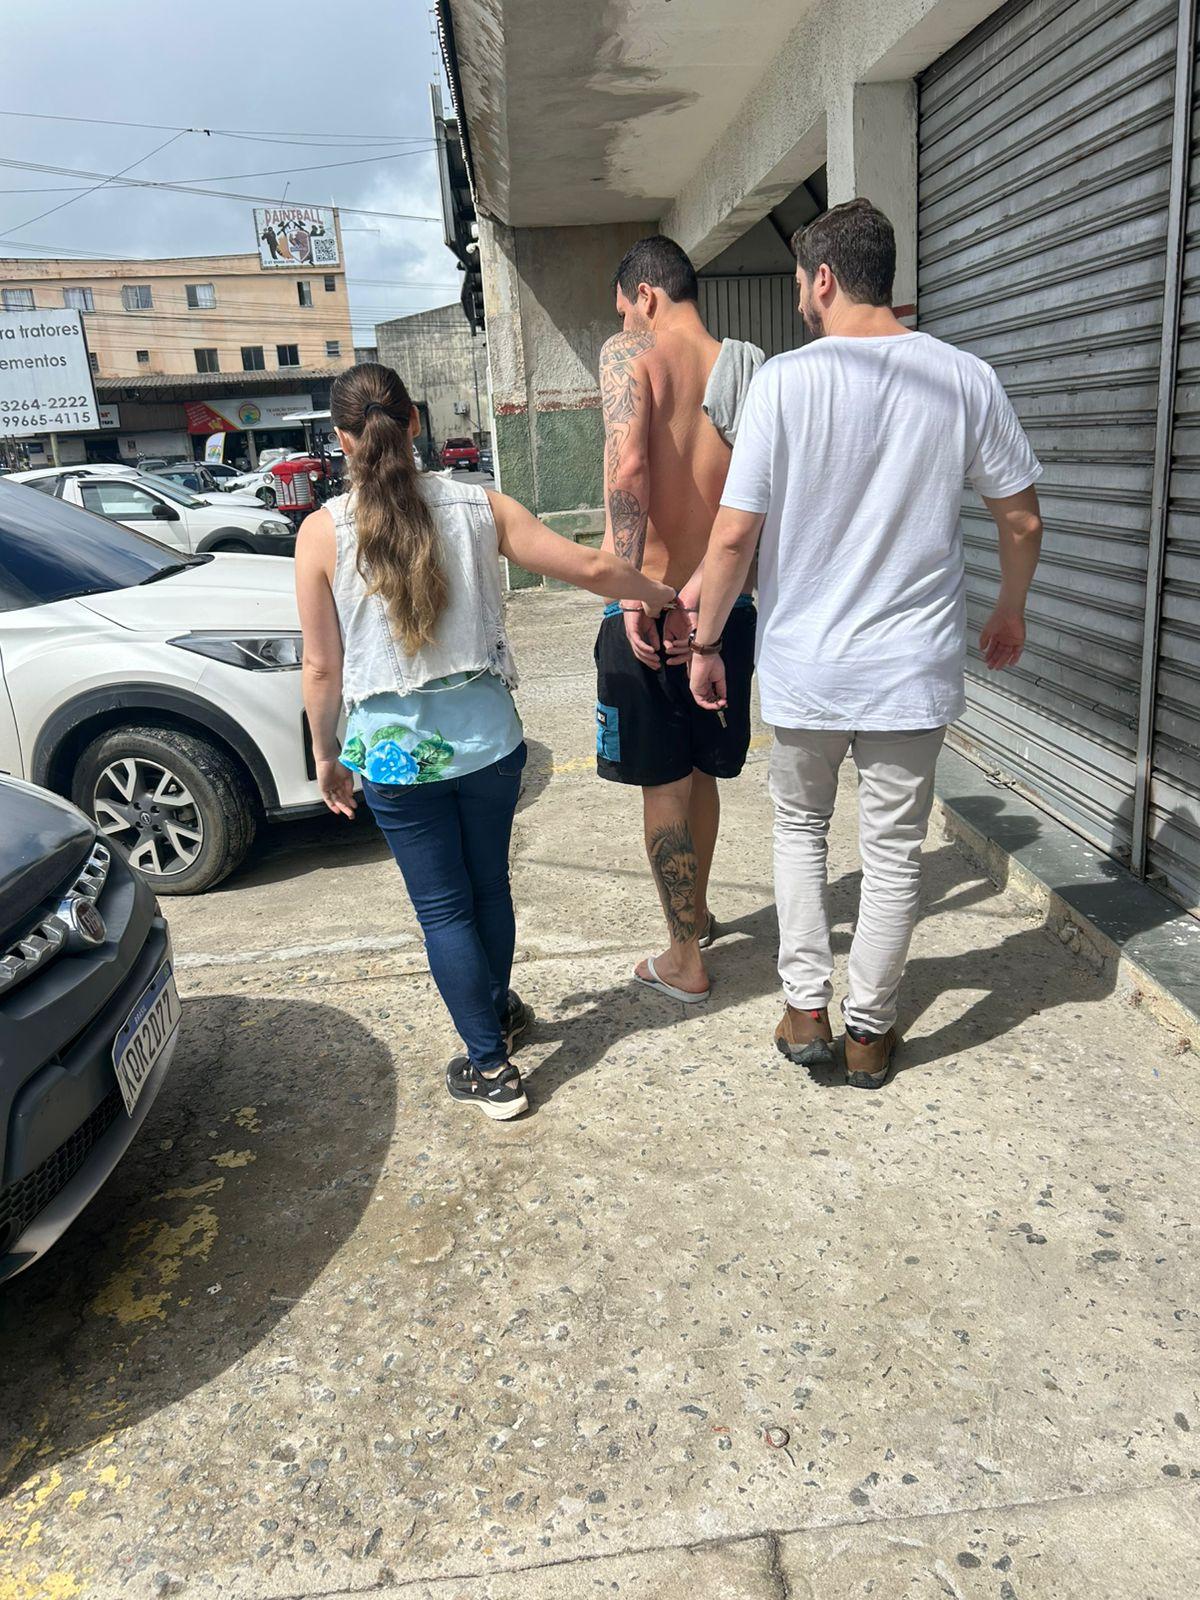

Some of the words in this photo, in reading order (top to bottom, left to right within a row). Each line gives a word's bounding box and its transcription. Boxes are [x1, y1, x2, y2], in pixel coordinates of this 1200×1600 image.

[264, 209, 324, 227] PAINTBALL
[19, 323, 79, 339] tratores
[0, 354, 67, 370] ementos
[0, 396, 88, 412] 3264-2222
[3, 412, 91, 427] 99665-4115
[121, 988, 173, 1099] KQR2D77
